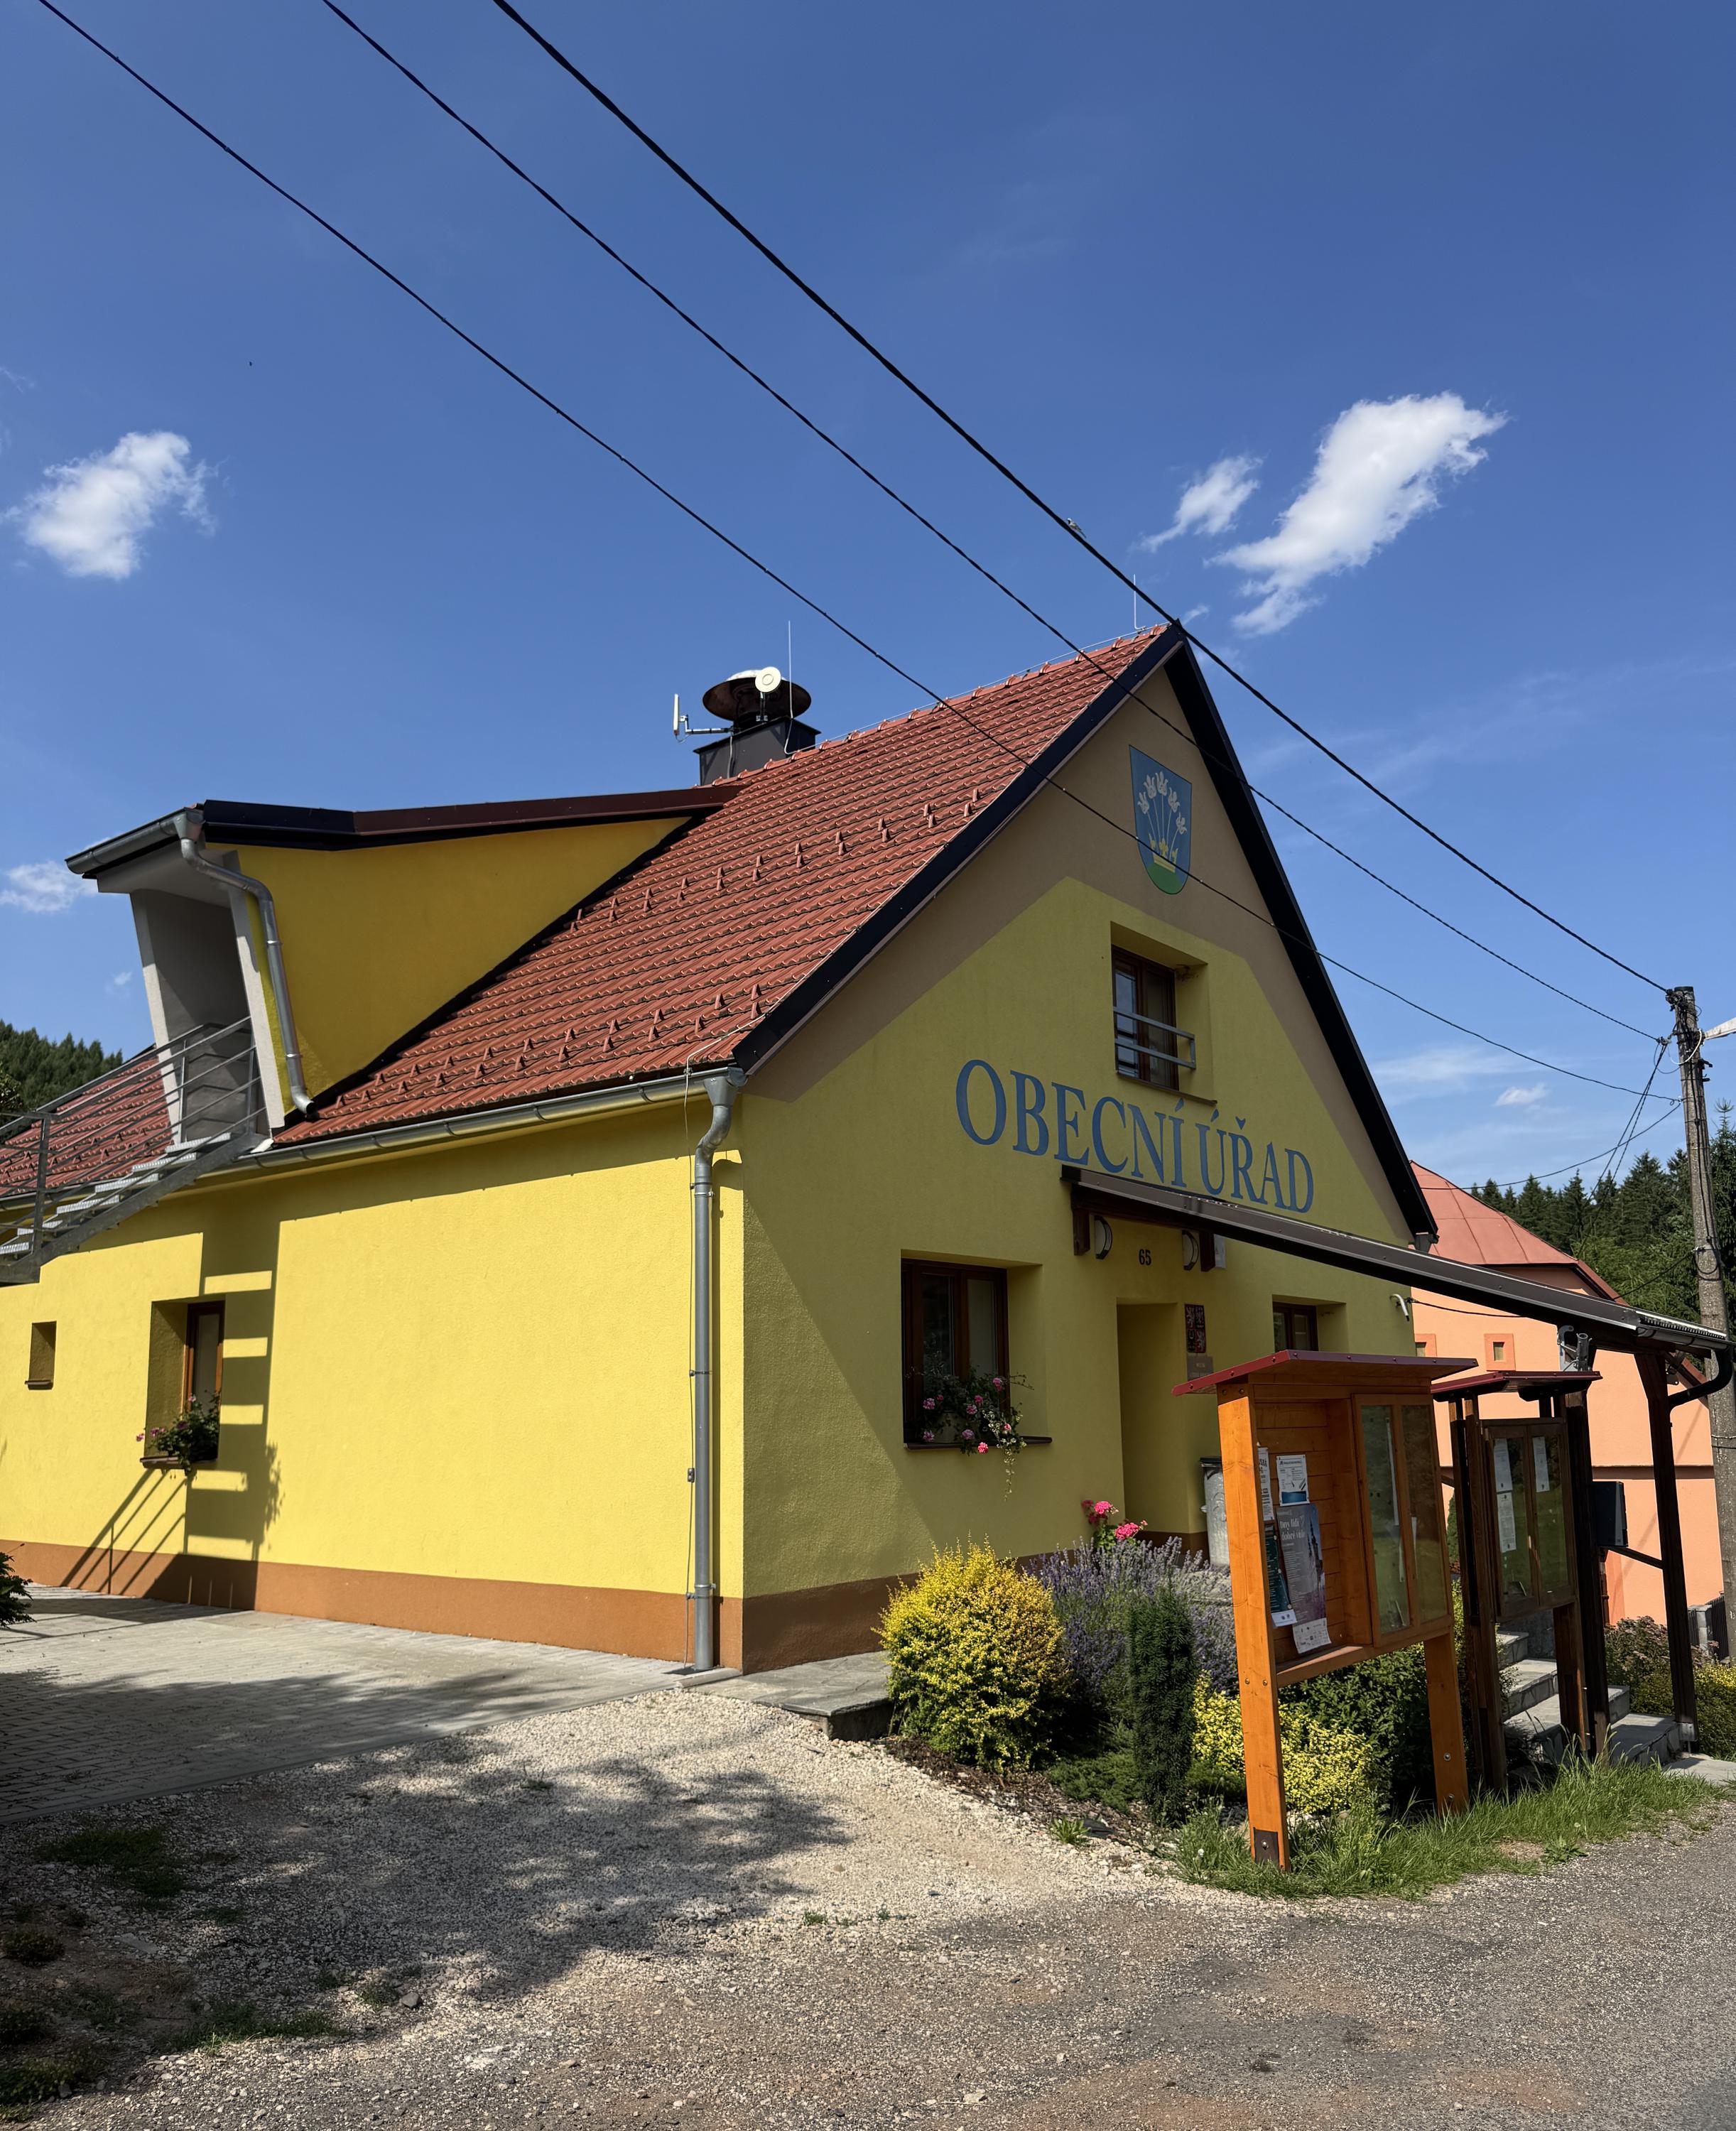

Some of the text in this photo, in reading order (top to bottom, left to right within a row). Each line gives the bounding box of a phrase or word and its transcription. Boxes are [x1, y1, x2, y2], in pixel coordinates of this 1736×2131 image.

[955, 1059, 1314, 1213] OBECNÍ ÚŘAD
[1139, 1249, 1151, 1266] 65
